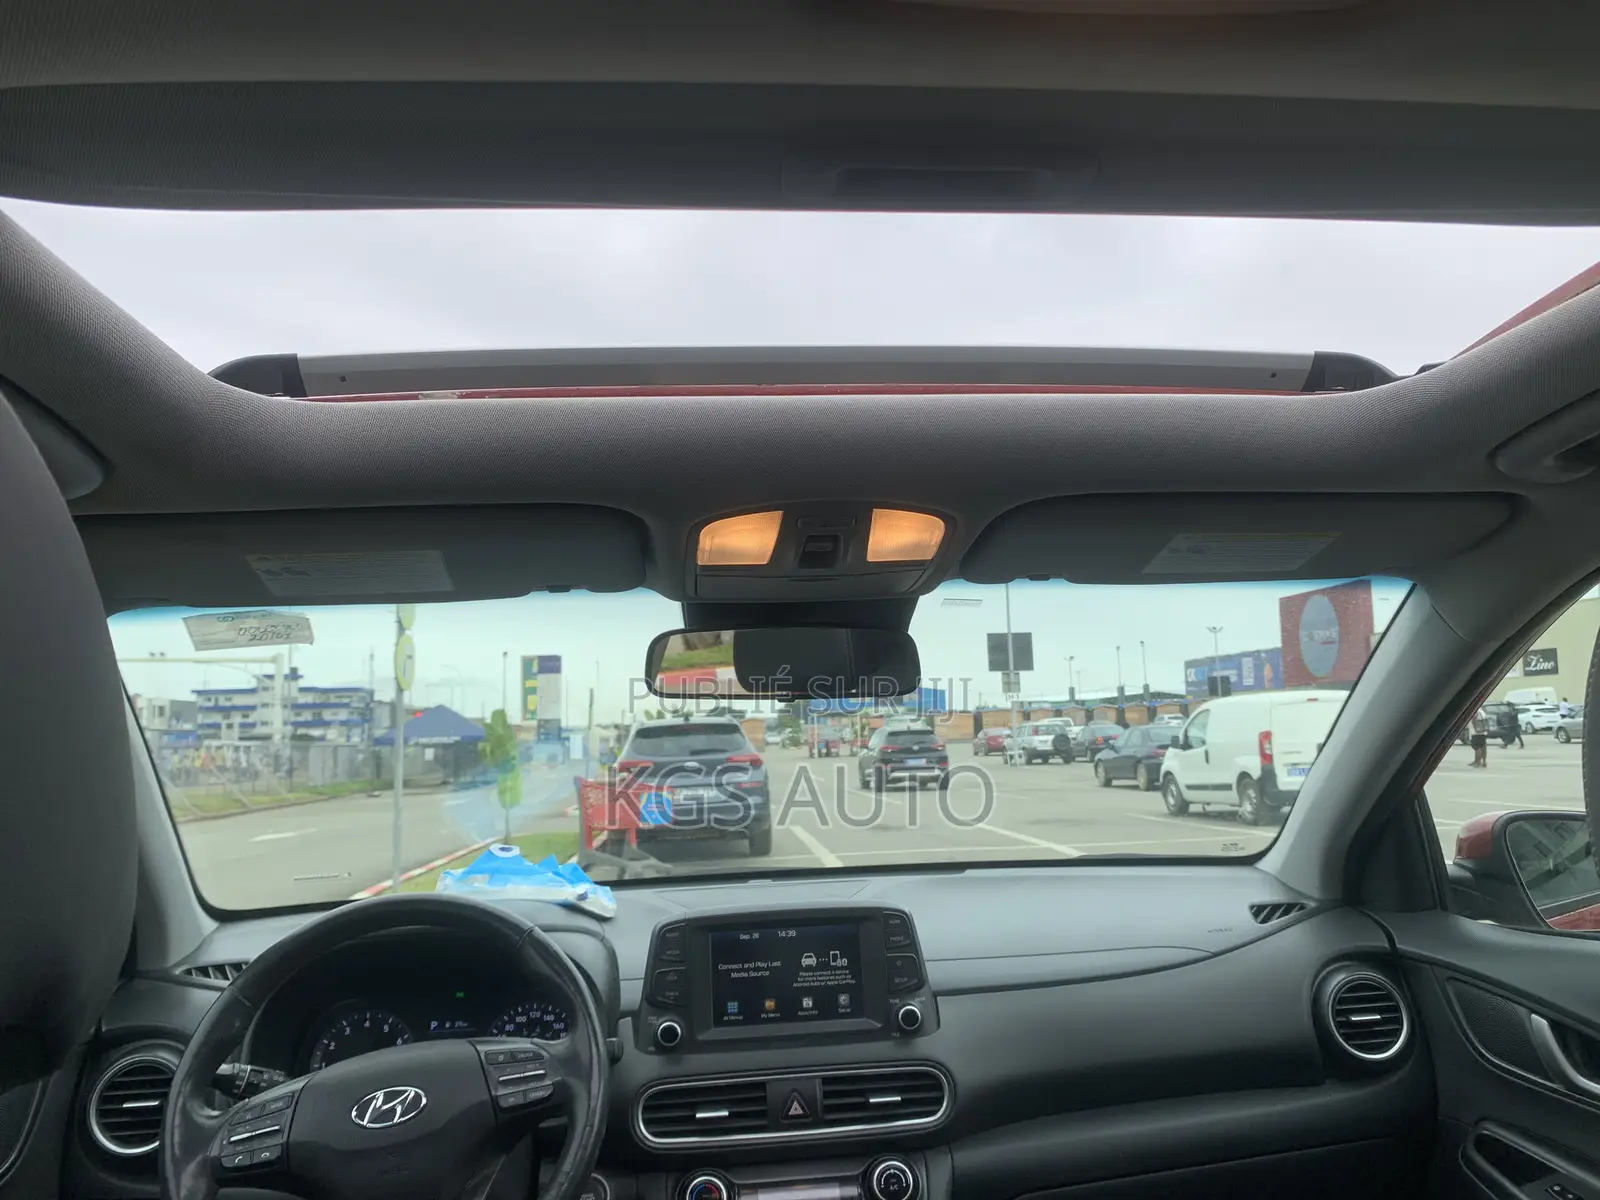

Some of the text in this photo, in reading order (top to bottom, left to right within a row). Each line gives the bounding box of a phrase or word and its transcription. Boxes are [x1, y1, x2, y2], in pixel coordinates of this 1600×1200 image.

[430, 1021, 438, 1030] P
[344, 1027, 350, 1035] 3
[329, 1042, 336, 1050] 2
